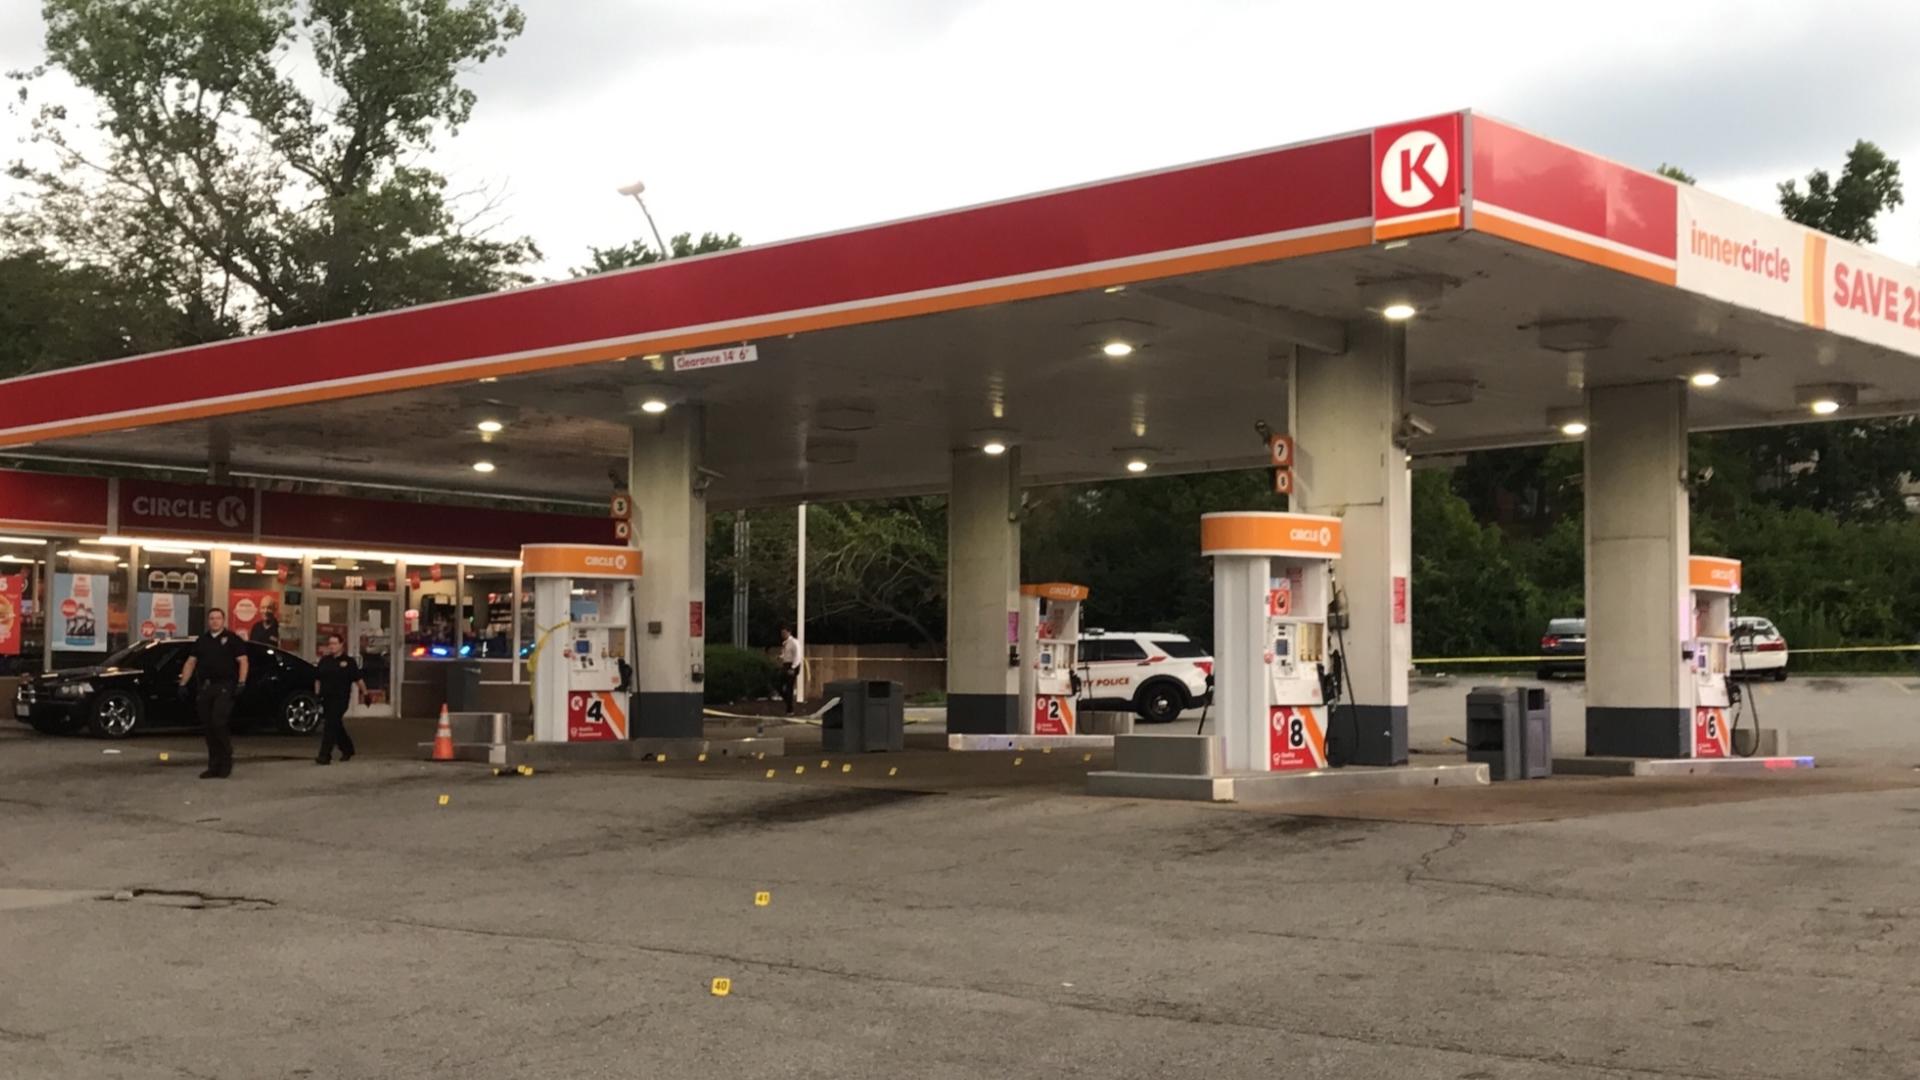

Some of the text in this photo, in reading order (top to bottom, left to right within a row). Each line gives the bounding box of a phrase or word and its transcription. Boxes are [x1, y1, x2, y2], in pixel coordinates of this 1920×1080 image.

[1691, 219, 1790, 283] innercircle
[1834, 262, 1920, 331] SAVE 2
[677, 355, 721, 369] Clearance
[1278, 444, 1285, 457] 7
[132, 496, 245, 527] CIRCLE K
[1096, 677, 1130, 687] POLICE
[587, 700, 604, 722] 4
[1049, 700, 1059, 719] 2
[1290, 719, 1304, 747] 8
[1709, 716, 1717, 737] 6
[714, 980, 728, 991] 40
